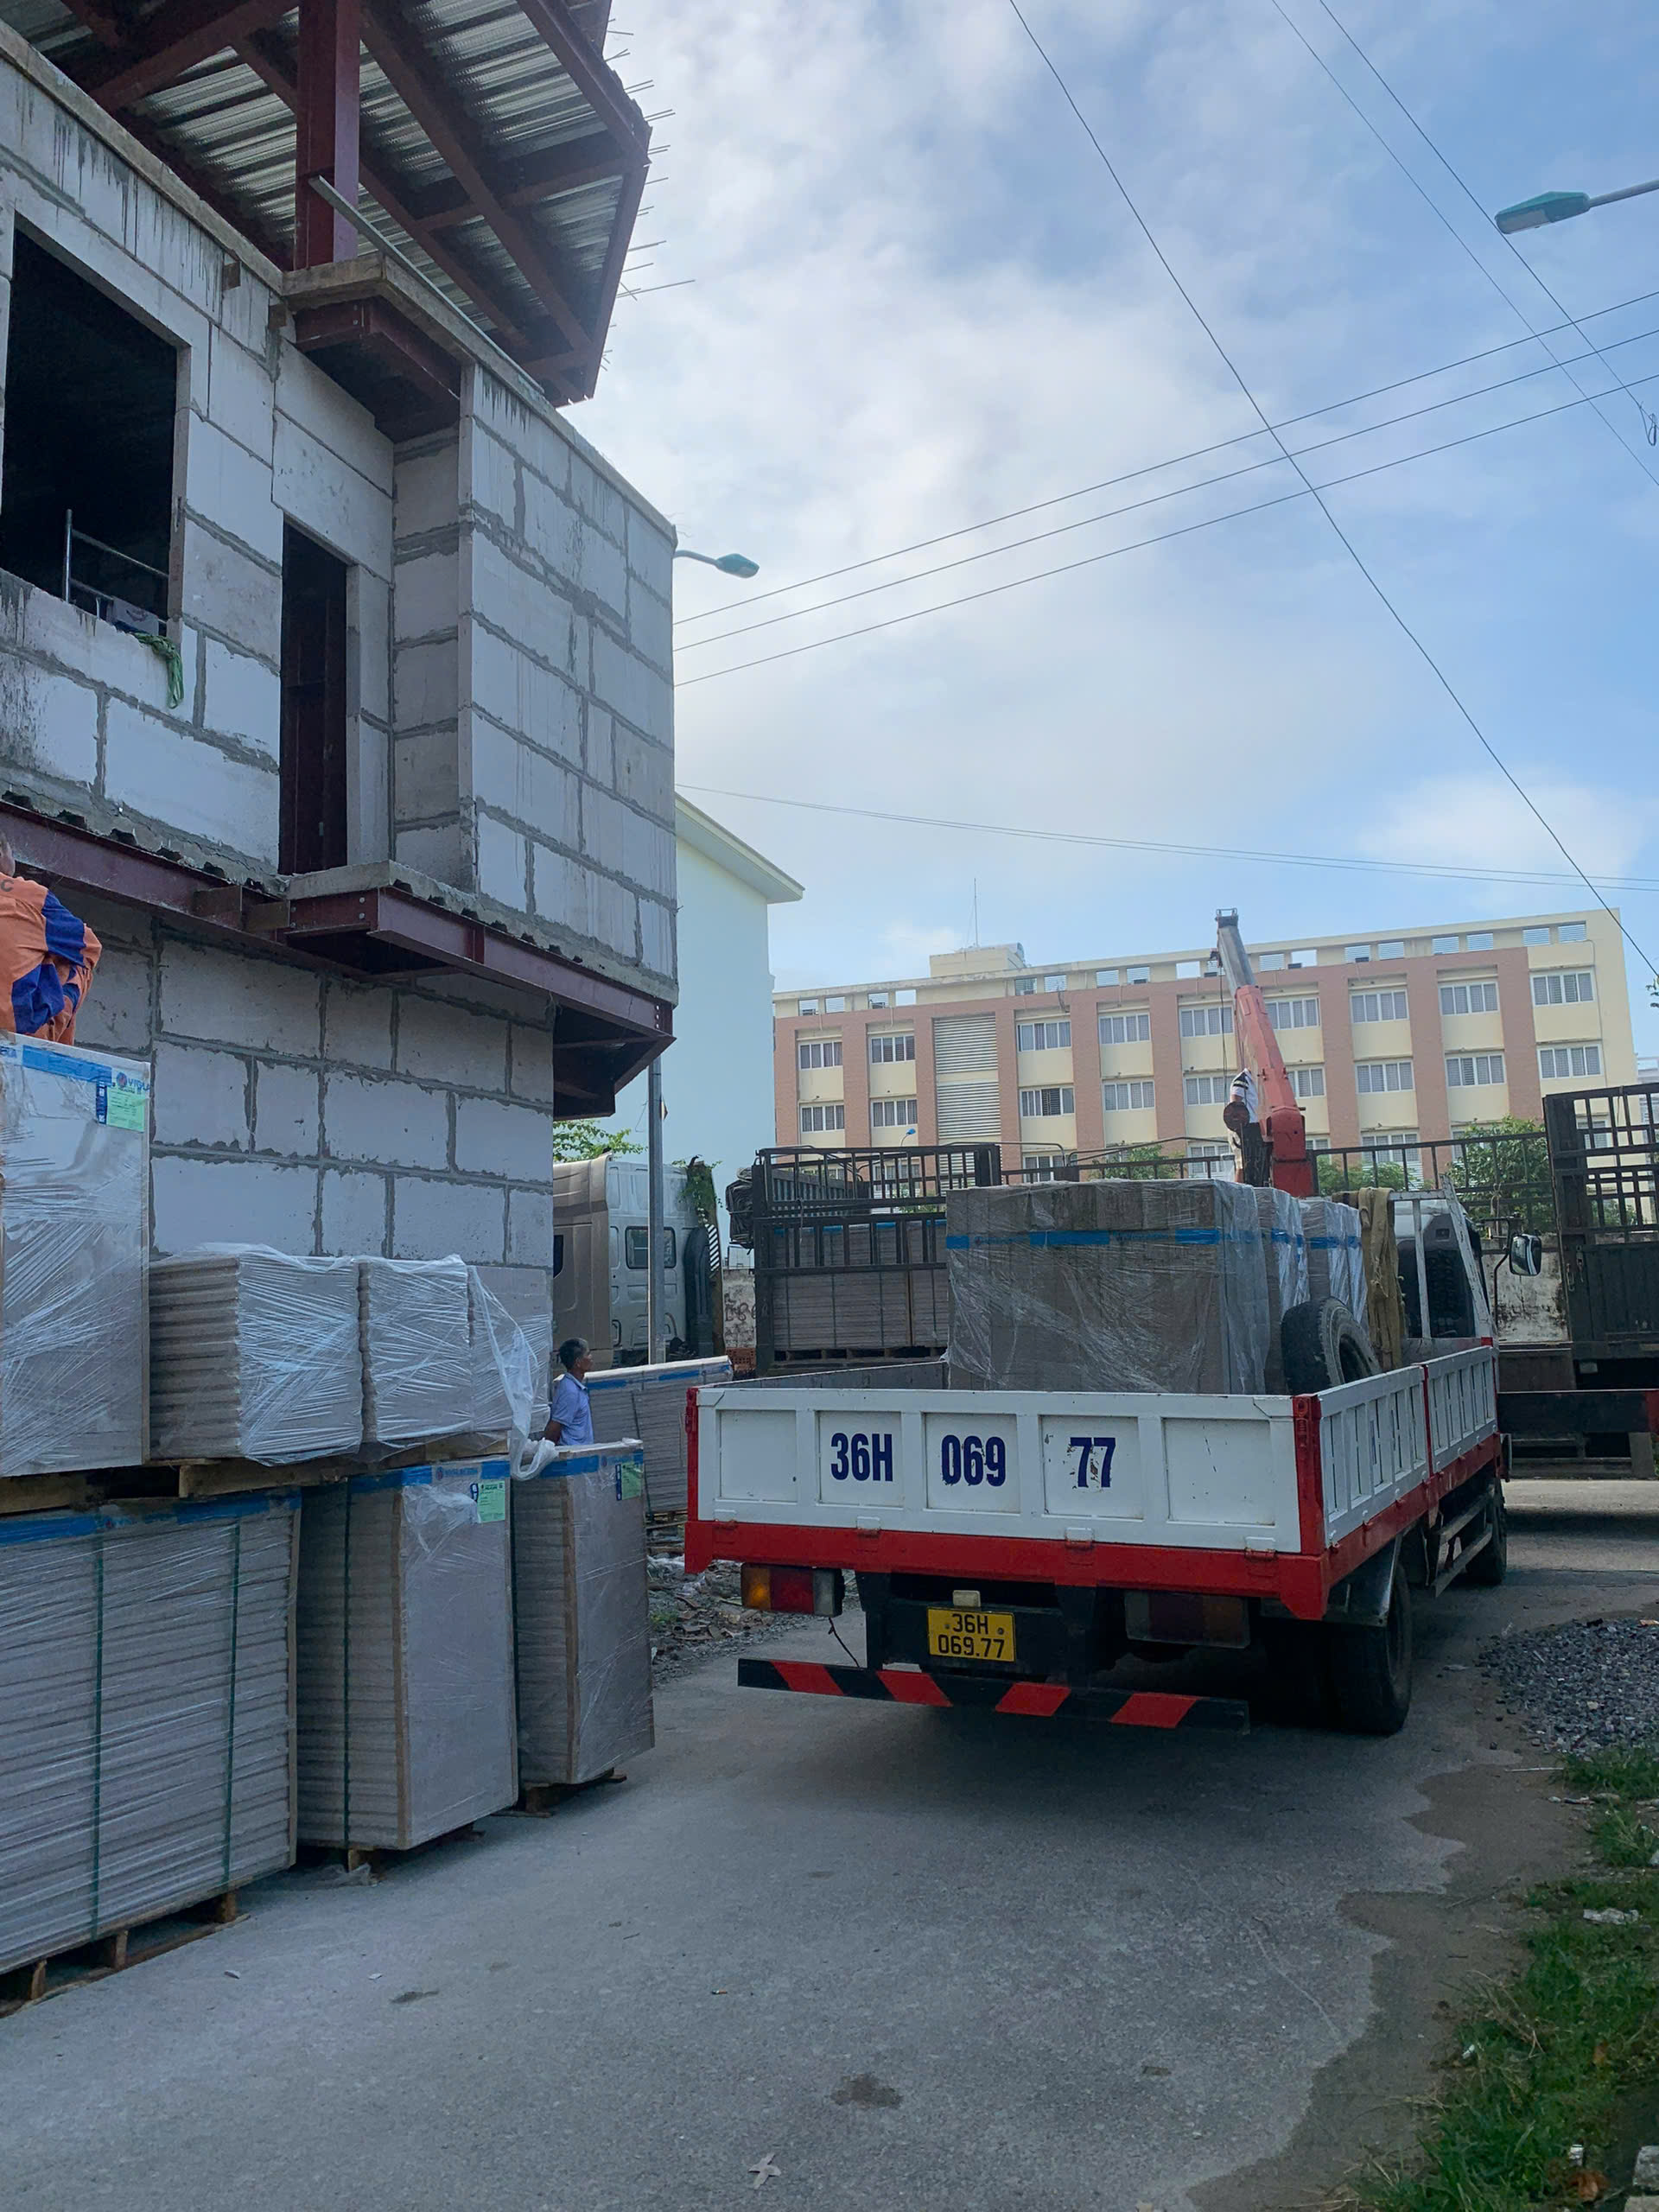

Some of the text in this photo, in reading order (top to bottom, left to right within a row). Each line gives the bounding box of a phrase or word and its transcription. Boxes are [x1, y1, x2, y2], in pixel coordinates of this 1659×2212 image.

[830, 1432, 1116, 1489] 36H 069 77
[951, 1612, 989, 1635] 36H
[938, 1633, 1005, 1659] 069.77
